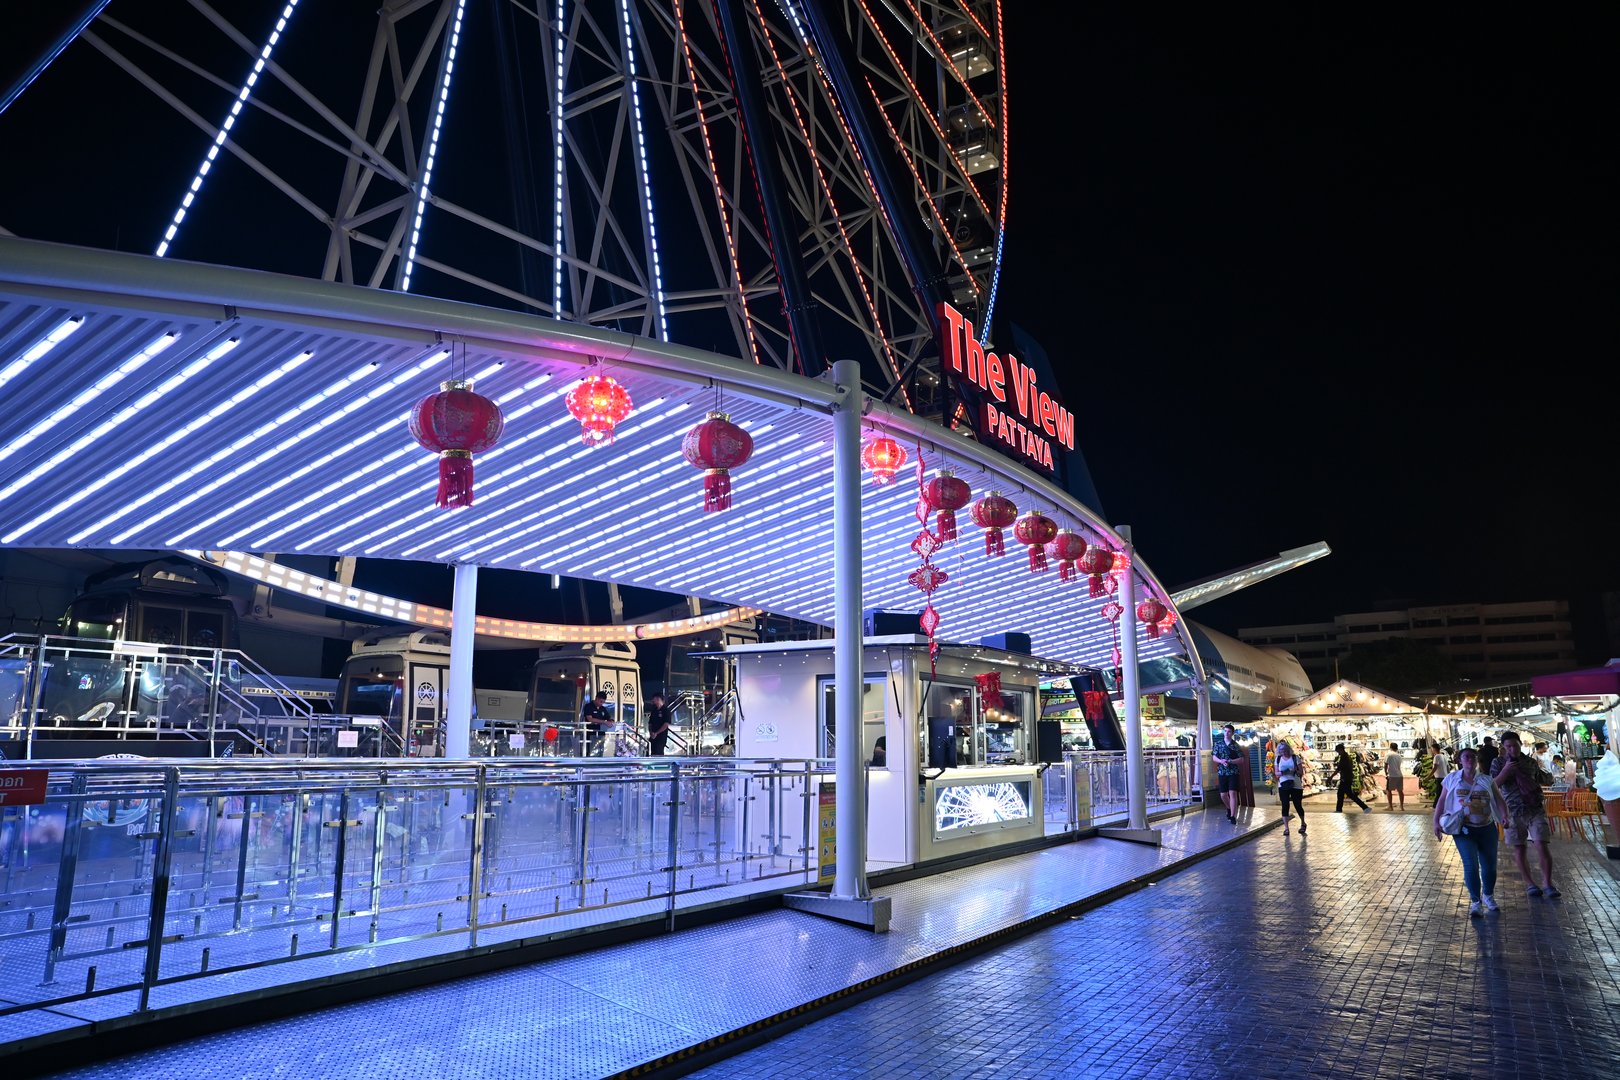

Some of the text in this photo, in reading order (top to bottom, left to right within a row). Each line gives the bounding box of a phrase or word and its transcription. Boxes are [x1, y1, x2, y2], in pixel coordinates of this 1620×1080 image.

[944, 301, 1074, 450] The View
[987, 403, 1054, 471] PATTAYA
